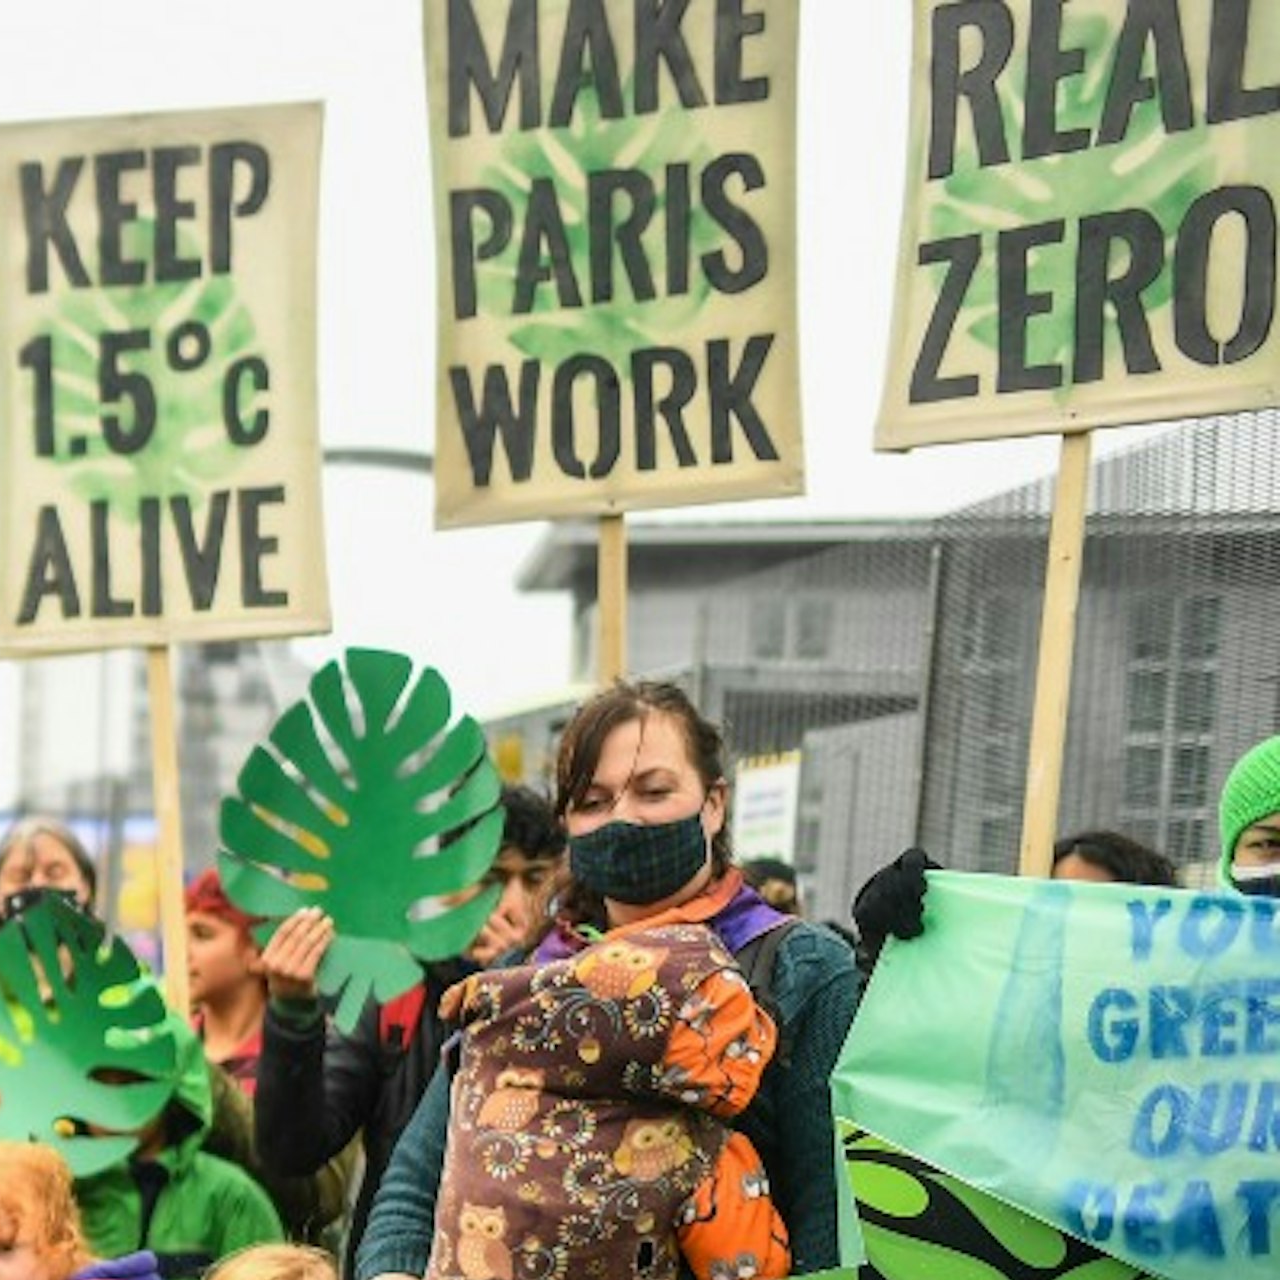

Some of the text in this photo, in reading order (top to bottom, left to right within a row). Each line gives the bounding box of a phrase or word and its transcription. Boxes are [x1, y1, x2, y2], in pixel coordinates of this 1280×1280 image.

[446, 0, 771, 140] MAKE
[927, 0, 1280, 182] REAL
[16, 139, 272, 295] KEEP
[447, 151, 771, 322] PARIS
[908, 184, 1278, 405] ZERO
[447, 332, 782, 488] WORK
[15, 485, 290, 627] ALIVE
